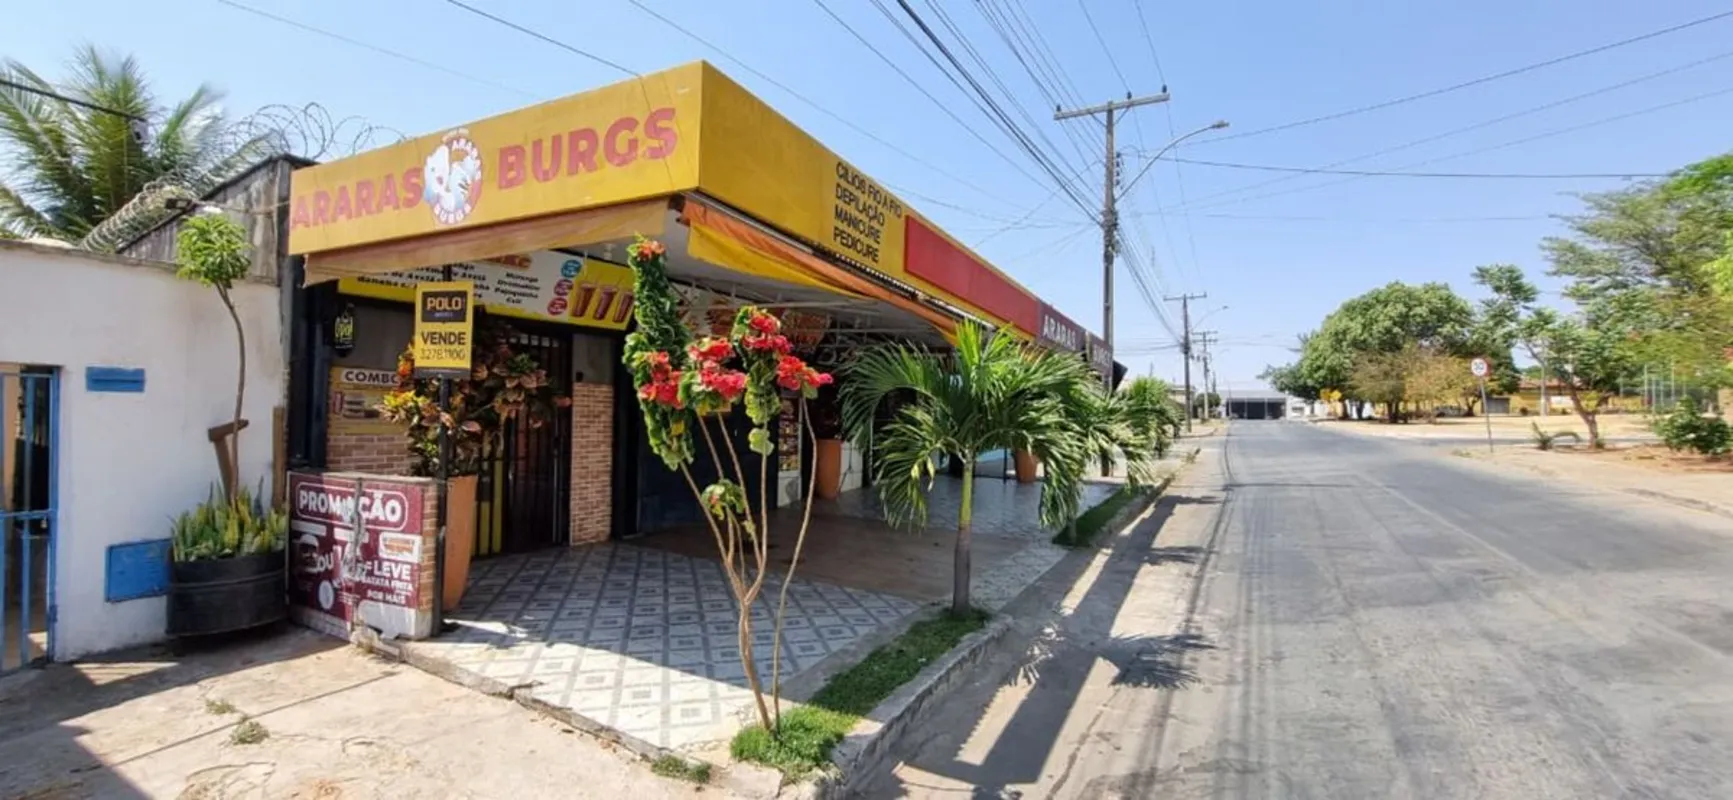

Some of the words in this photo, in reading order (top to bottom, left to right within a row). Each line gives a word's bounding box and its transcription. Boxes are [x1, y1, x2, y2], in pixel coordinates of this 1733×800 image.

[498, 107, 678, 191] BURGS
[289, 167, 422, 230] ARARAS
[836, 182, 885, 227] DEPILAÇÃO
[835, 203, 881, 245] MANICURE
[833, 226, 879, 263] PEDICURE
[427, 297, 461, 311] POLO
[421, 331, 466, 346] VENDE
[373, 560, 411, 581] LEVE
